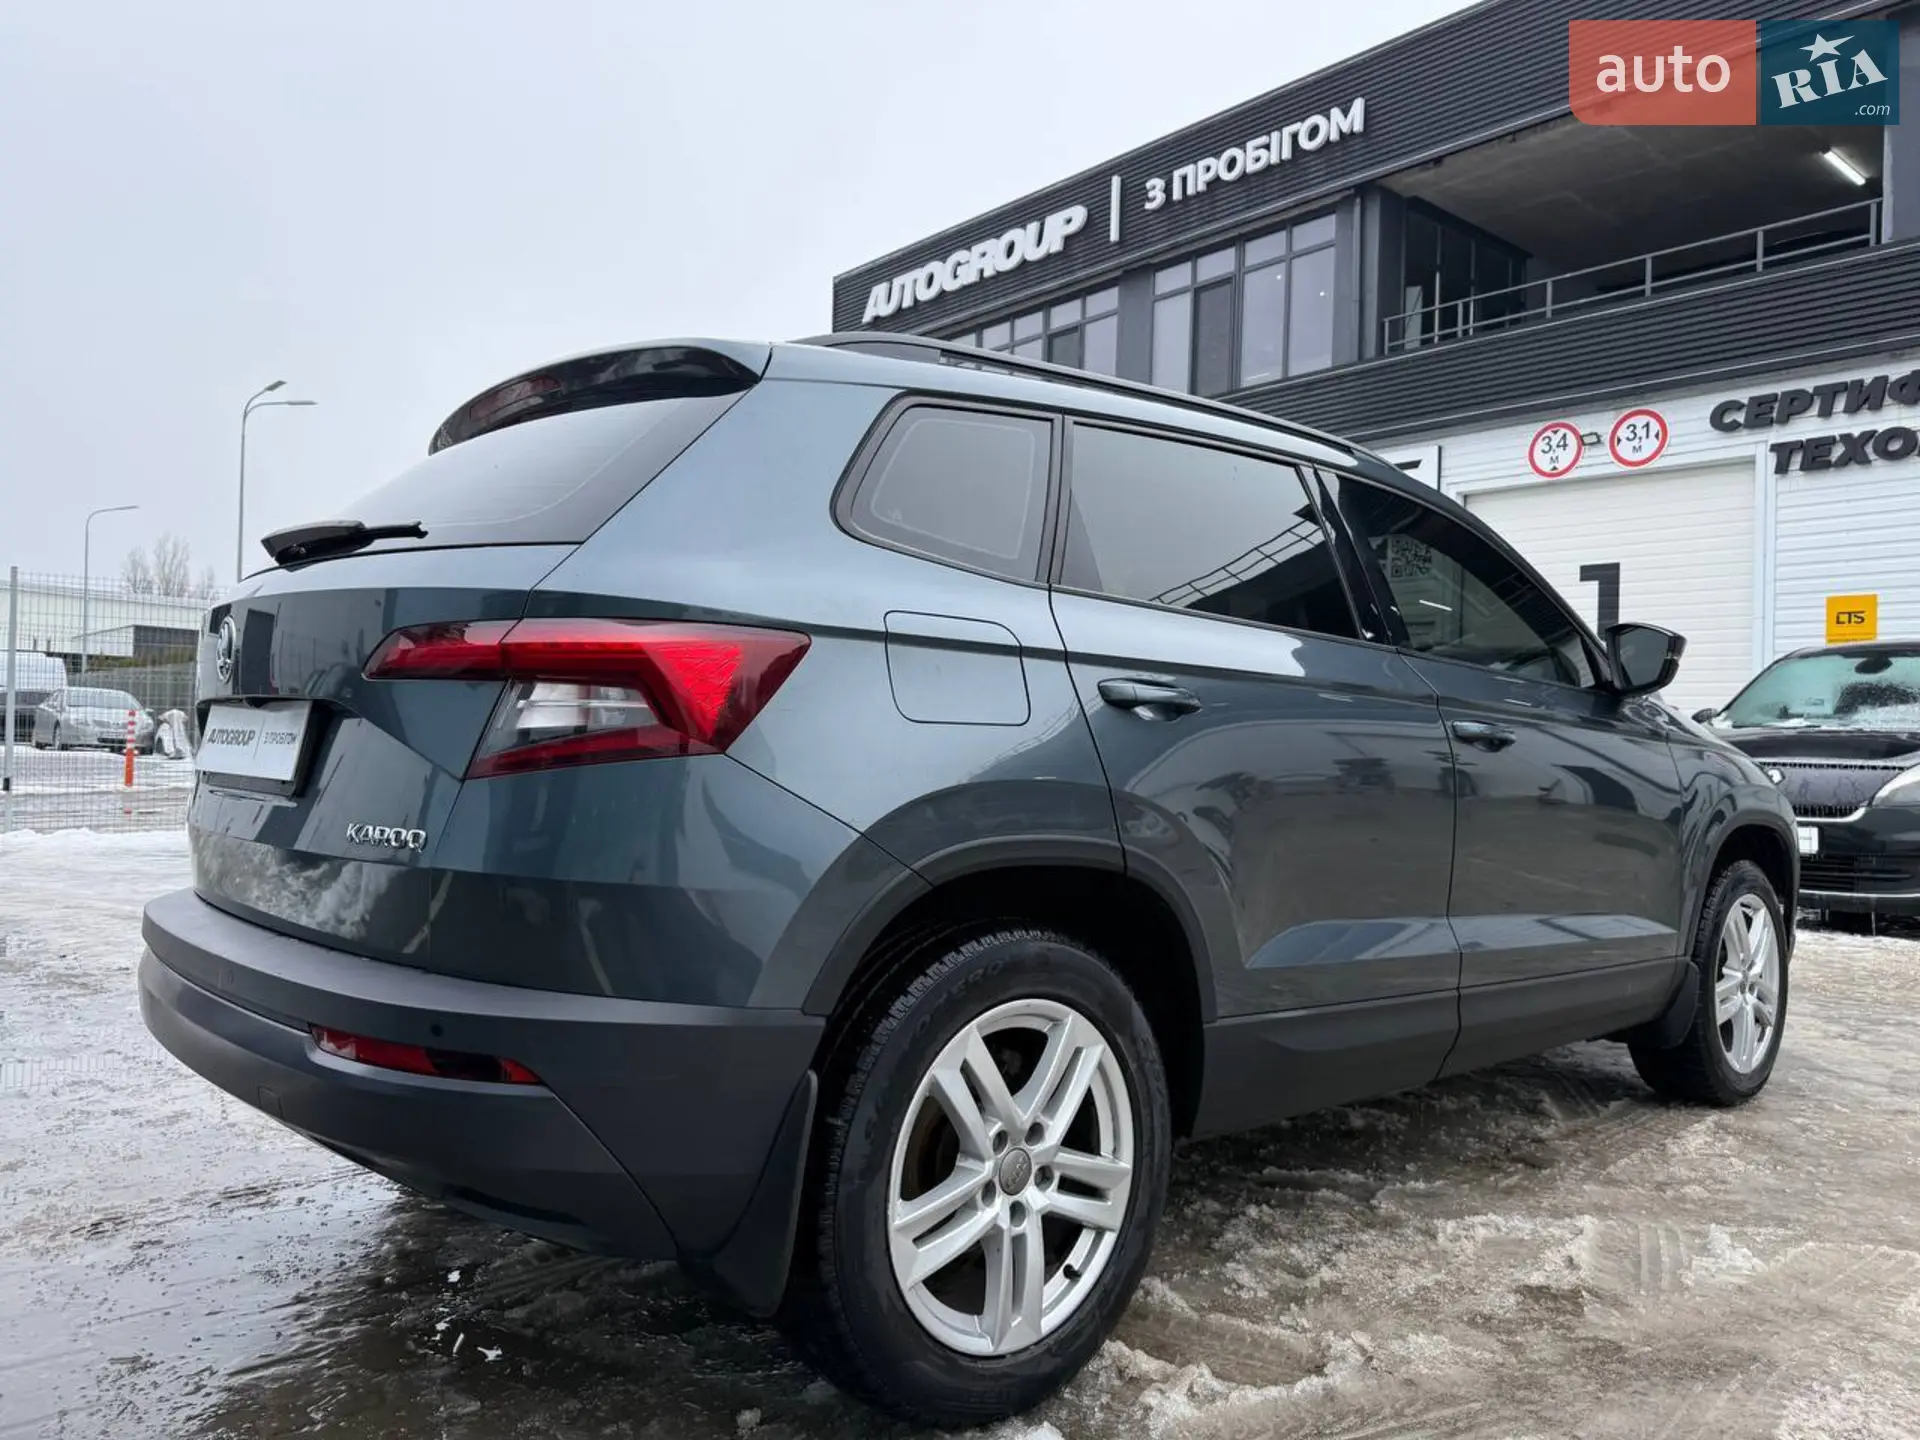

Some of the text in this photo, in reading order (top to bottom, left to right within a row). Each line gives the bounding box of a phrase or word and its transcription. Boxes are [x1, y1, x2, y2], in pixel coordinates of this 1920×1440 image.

[1172, 97, 1366, 201] ПРОБІГОМ
[862, 204, 1088, 324] AUTOGROUP
[1540, 432, 1569, 454] 3,4
[1625, 421, 1651, 444] 3,1
[1769, 426, 1920, 475] ТЕХО
[346, 823, 427, 852] KAROQ
